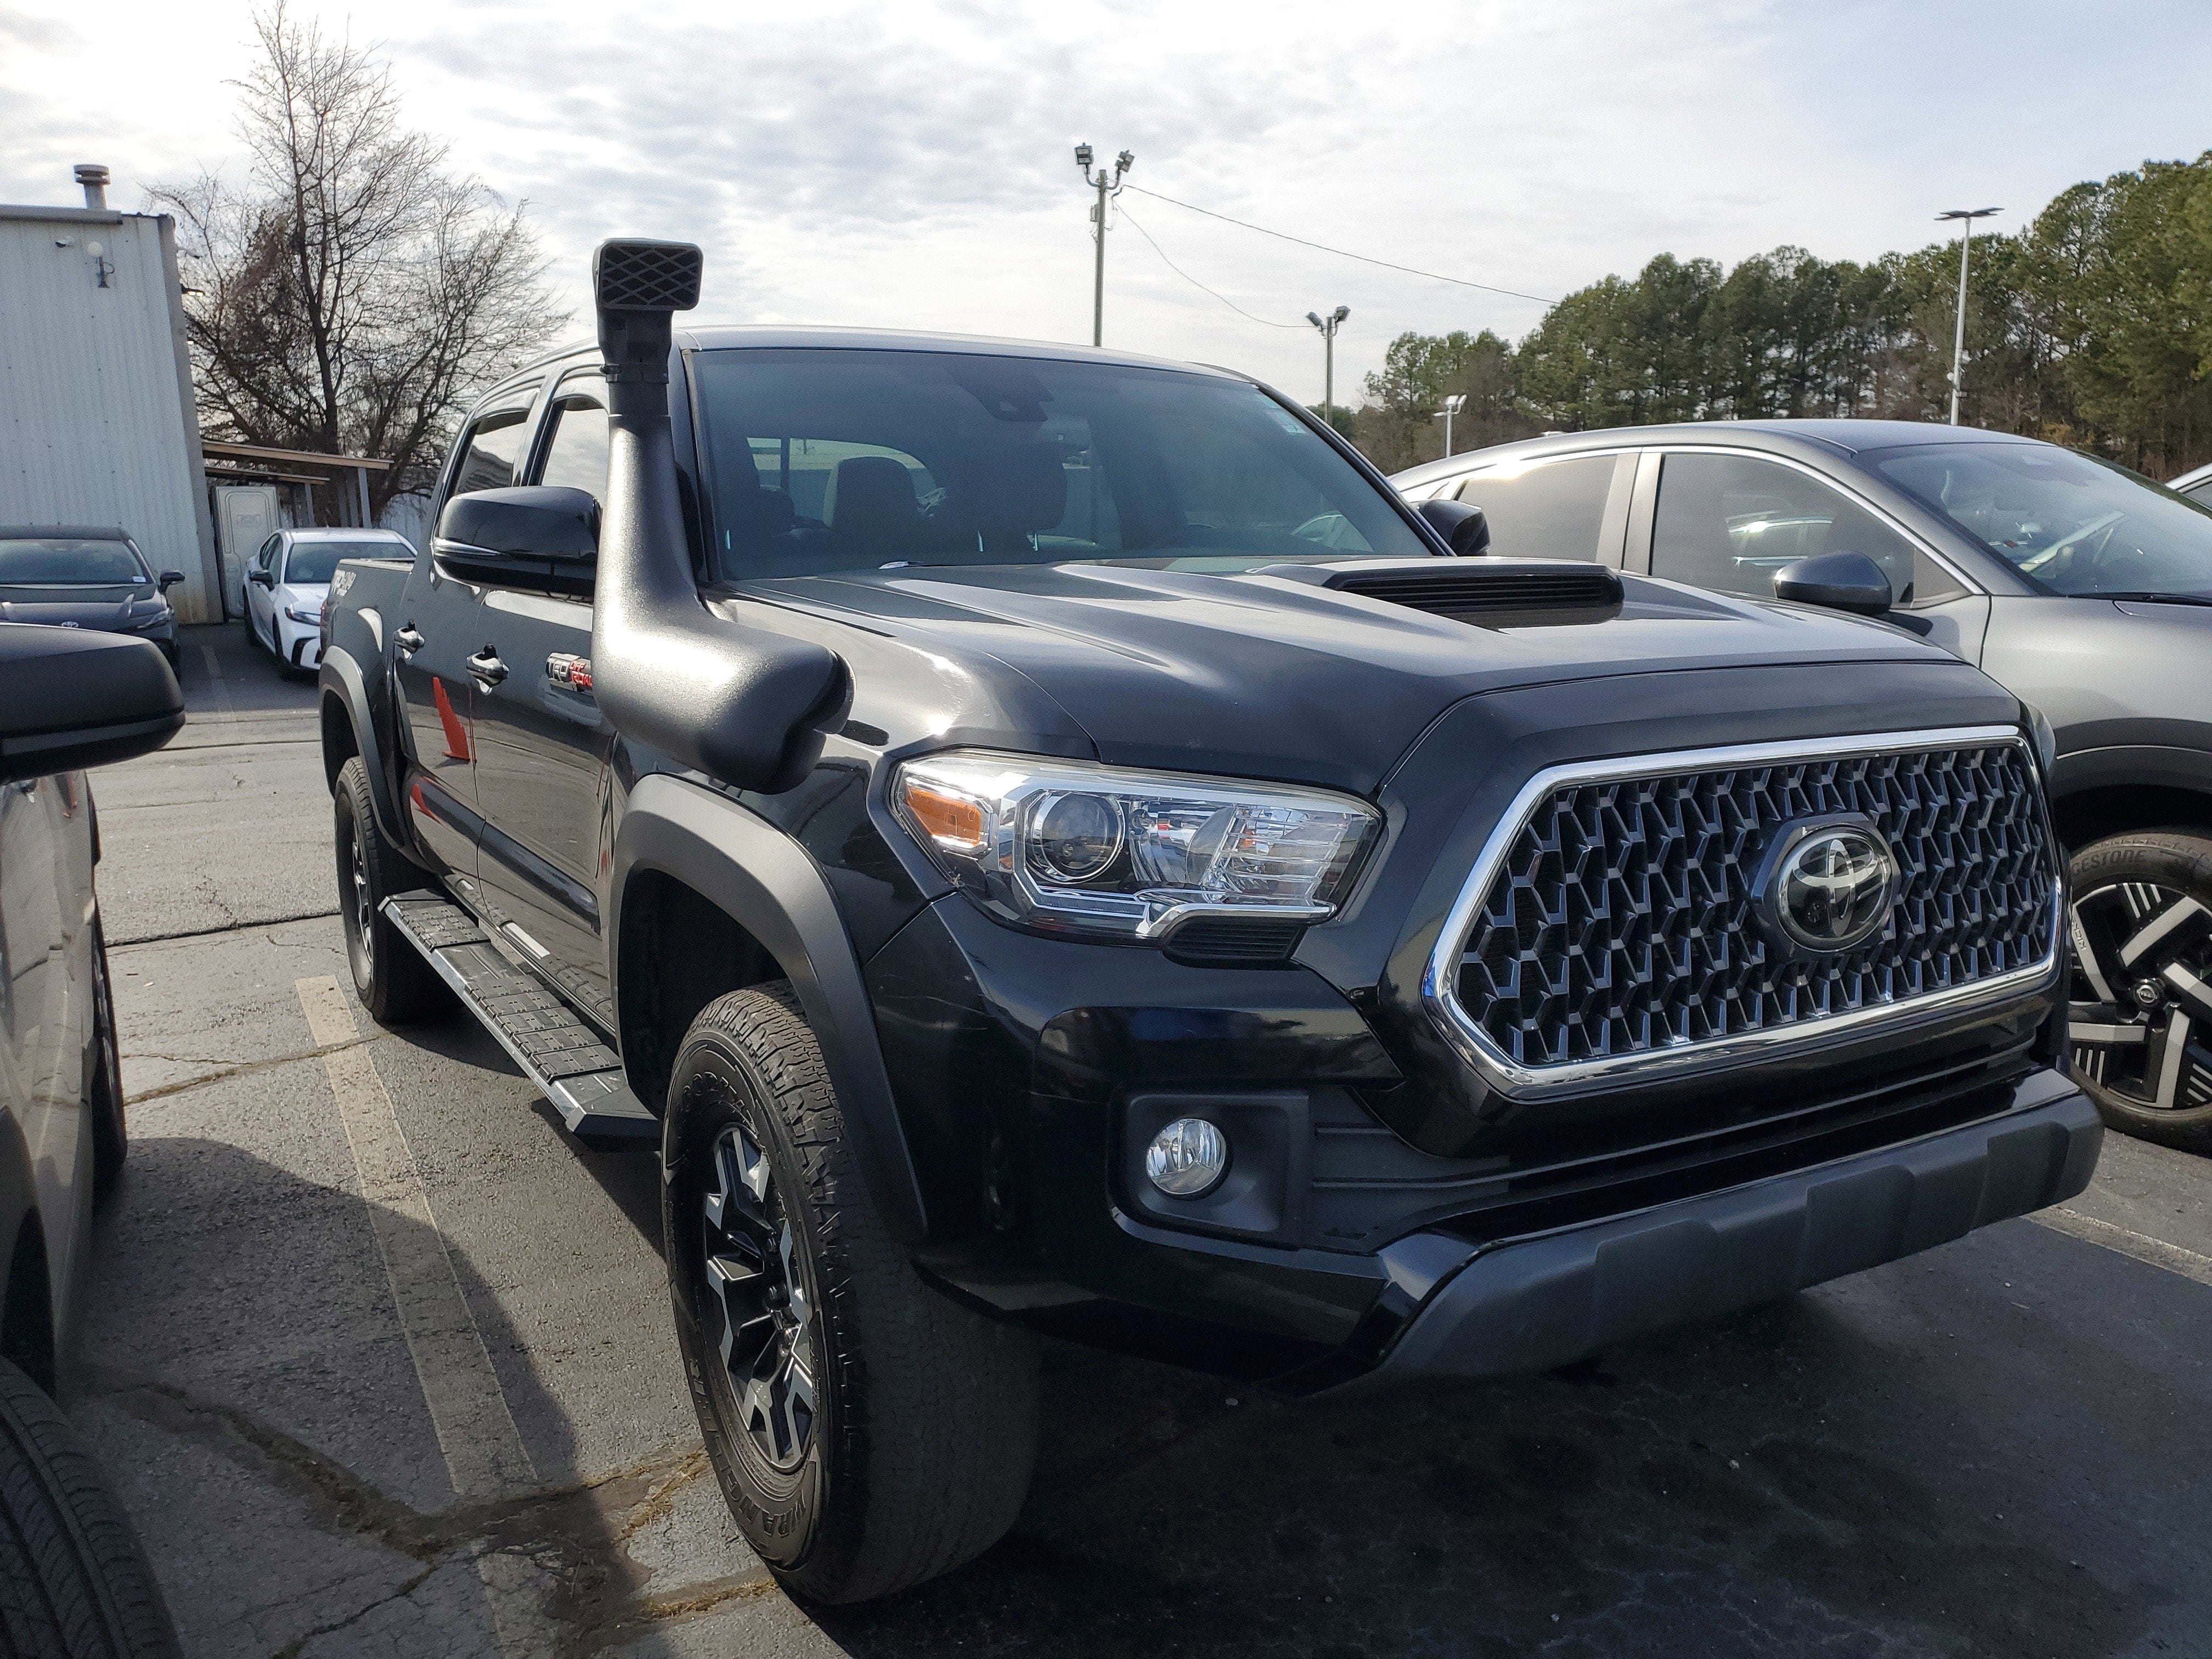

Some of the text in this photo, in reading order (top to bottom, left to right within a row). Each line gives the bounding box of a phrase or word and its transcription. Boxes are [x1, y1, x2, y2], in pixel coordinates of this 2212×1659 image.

[569, 661, 586, 672] OFF
[2071, 850, 2146, 873] GESTONE
[688, 1359, 806, 1537] WRANGLER
